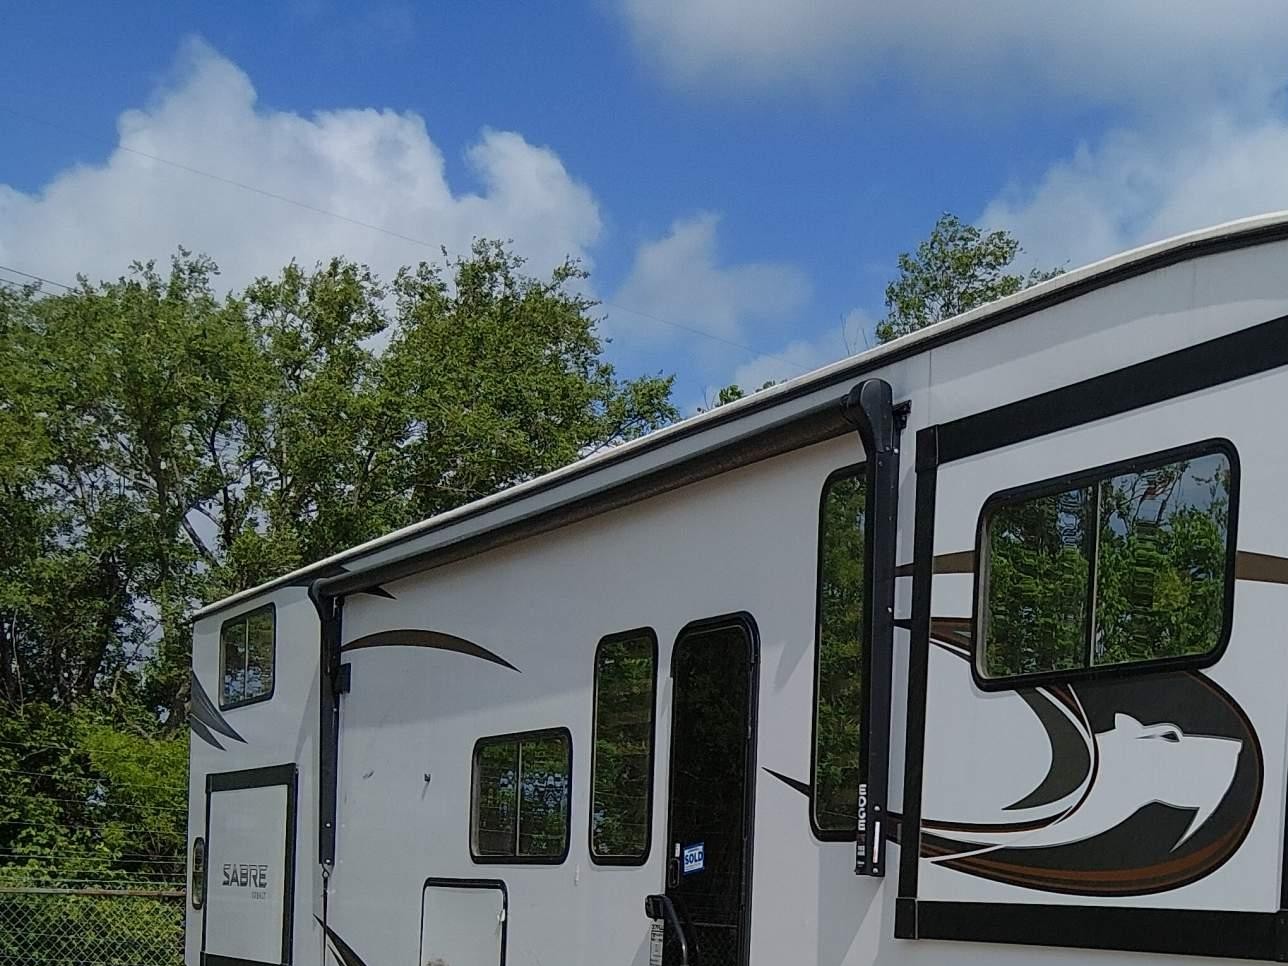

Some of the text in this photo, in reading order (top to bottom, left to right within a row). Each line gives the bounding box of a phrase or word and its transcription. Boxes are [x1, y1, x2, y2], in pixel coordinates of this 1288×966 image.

[858, 783, 867, 831] EDGE
[684, 851, 704, 865] SOLD
[222, 863, 268, 888] SABRE
